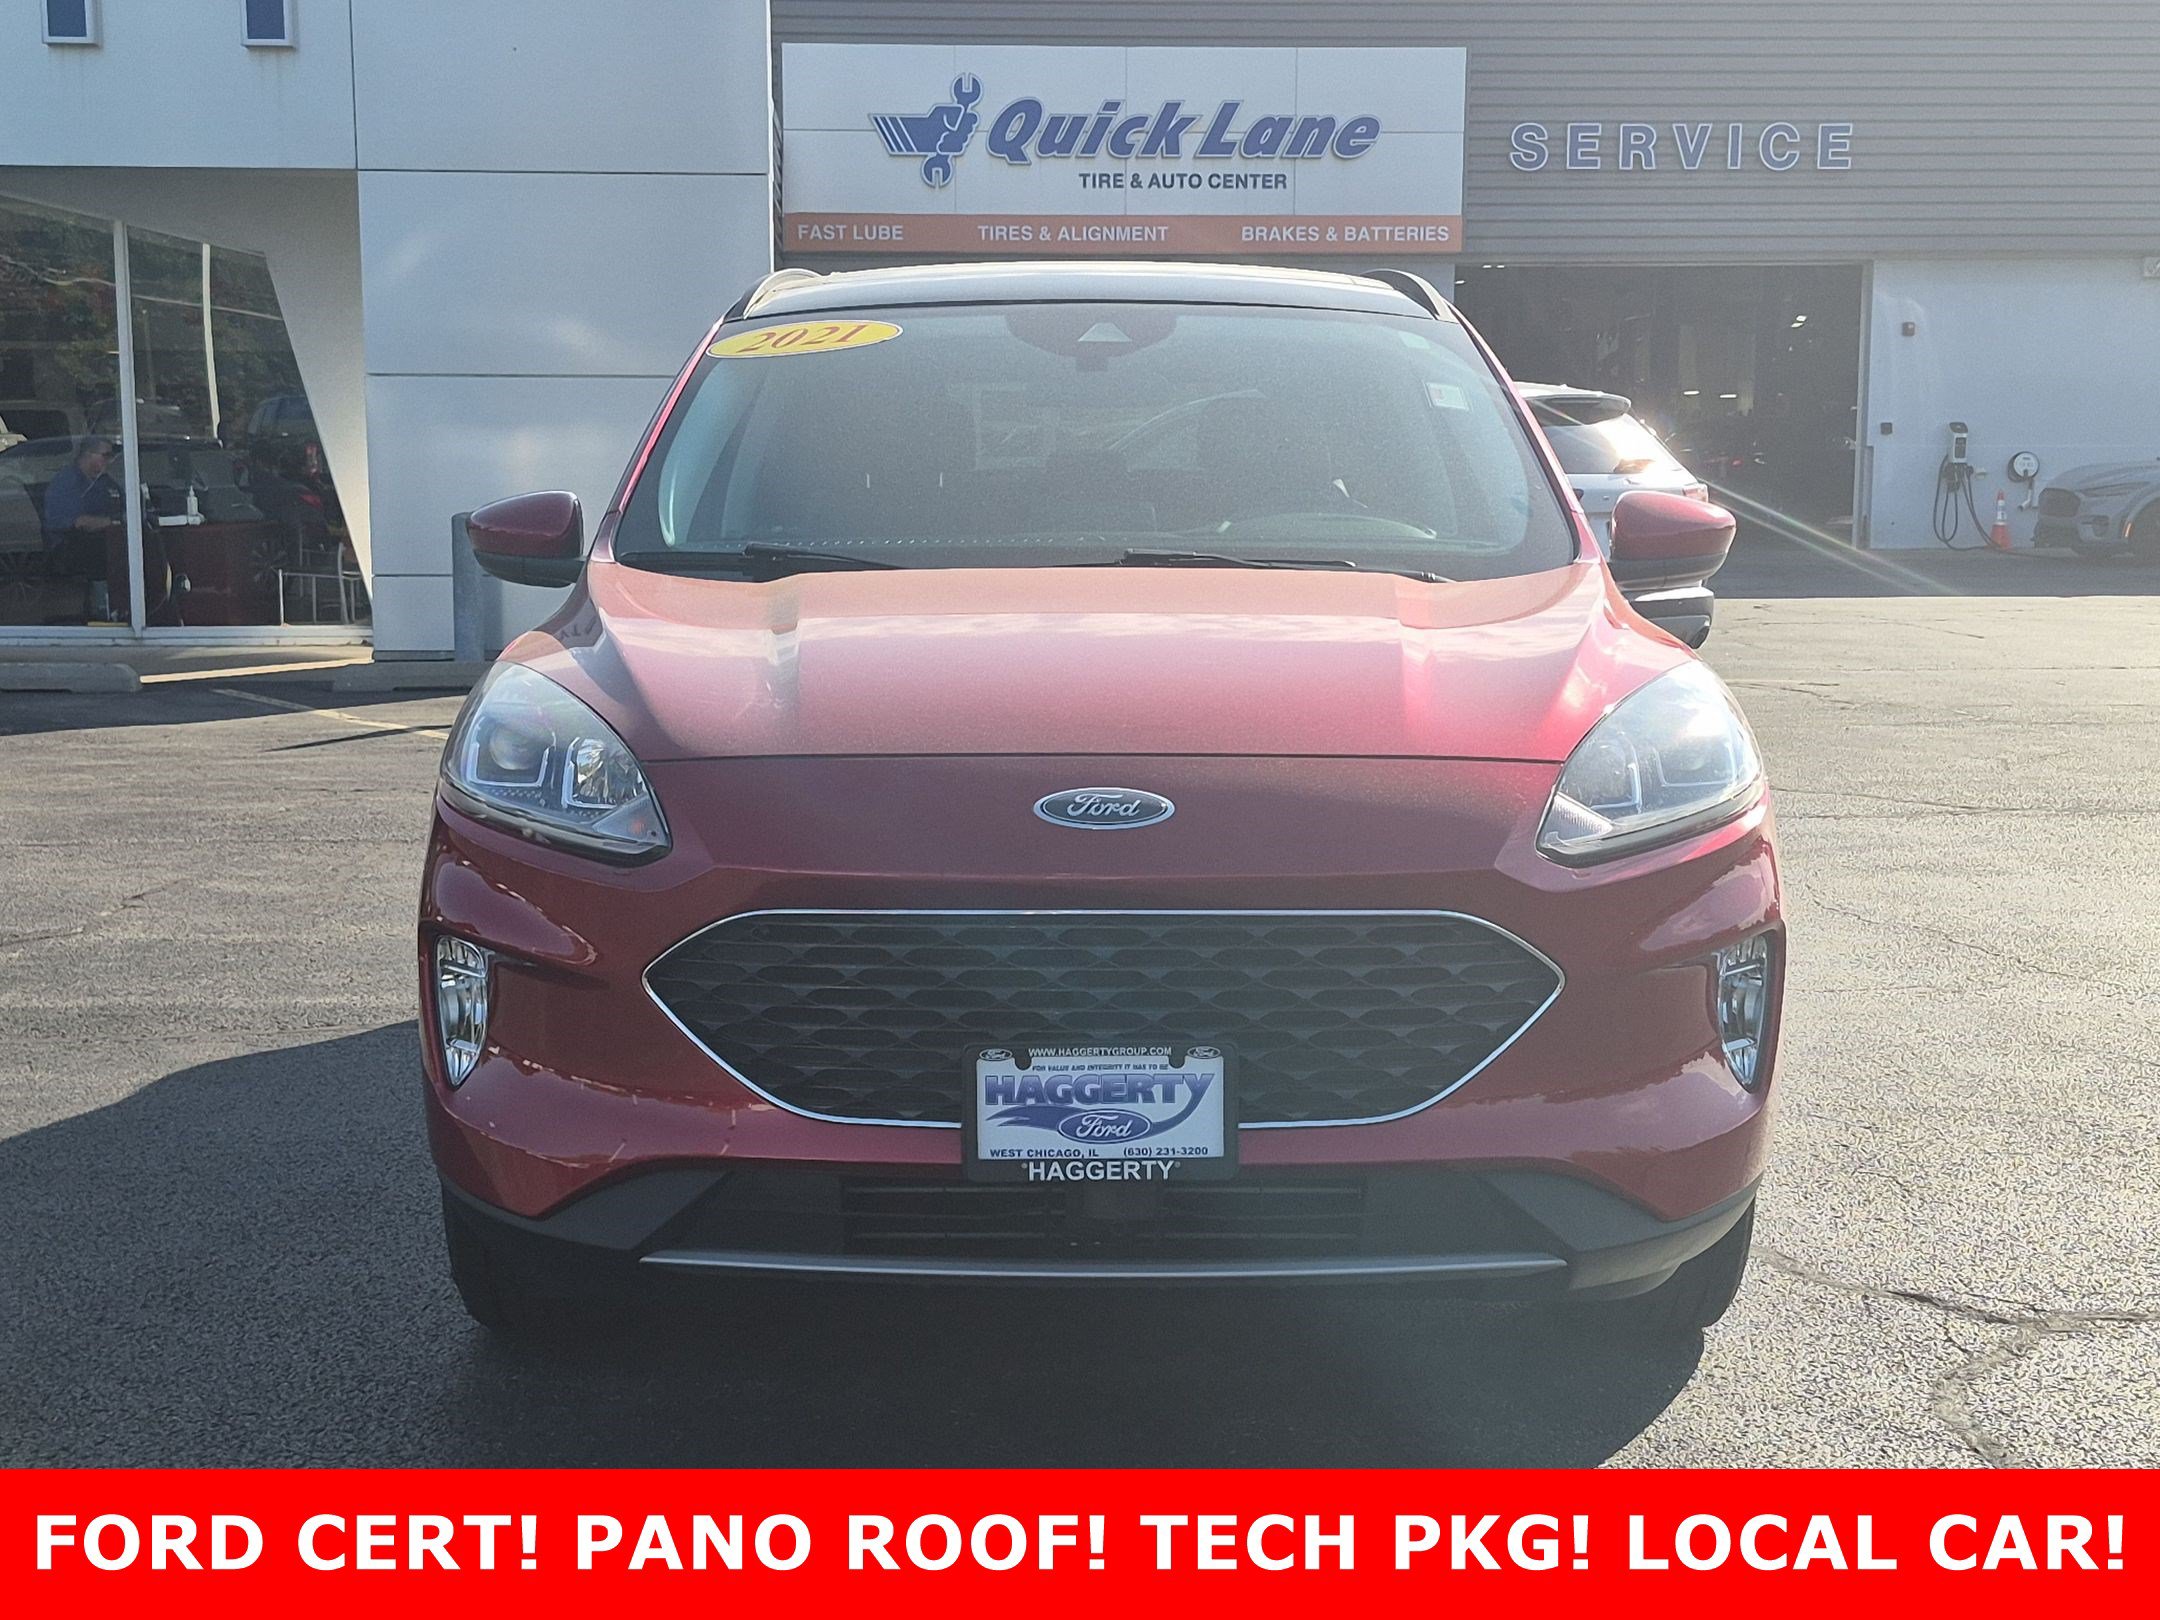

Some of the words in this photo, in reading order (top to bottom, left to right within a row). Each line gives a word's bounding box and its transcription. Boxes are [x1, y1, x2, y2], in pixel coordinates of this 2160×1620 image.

[985, 96, 1203, 165] Quick
[1194, 99, 1382, 159] Lane
[1510, 122, 1853, 171] SERVICE
[1079, 172, 1125, 189] TIRE
[1130, 172, 1144, 189] &
[1148, 172, 1203, 189] AUTO
[1208, 172, 1288, 189] CENTER
[798, 224, 847, 241] FAST
[853, 224, 904, 241] LUBE
[978, 225, 1033, 241] TIRES
[1039, 225, 1052, 241] &
[1057, 225, 1168, 242] ALIGNMENT
[1241, 226, 1320, 242] BRAKES
[1326, 226, 1338, 242] &
[1344, 226, 1449, 242] BATTERIES
[736, 324, 867, 353] 2021
[1067, 793, 1142, 816] Ford
[1028, 1047, 1172, 1057] WWW.HAGGERTYGROUP.COM
[984, 1073, 1216, 1106] HAGGERTY
[1075, 1115, 1132, 1139] Ford
[990, 1149, 1023, 1158] WEST
[1026, 1149, 1085, 1159] CHICAGO,
[1088, 1149, 1100, 1158] IL
[1123, 1147, 1153, 1157] (630)
[1156, 1147, 1209, 1156] 231-3200
[1028, 1160, 1175, 1181] HAGGERTY
